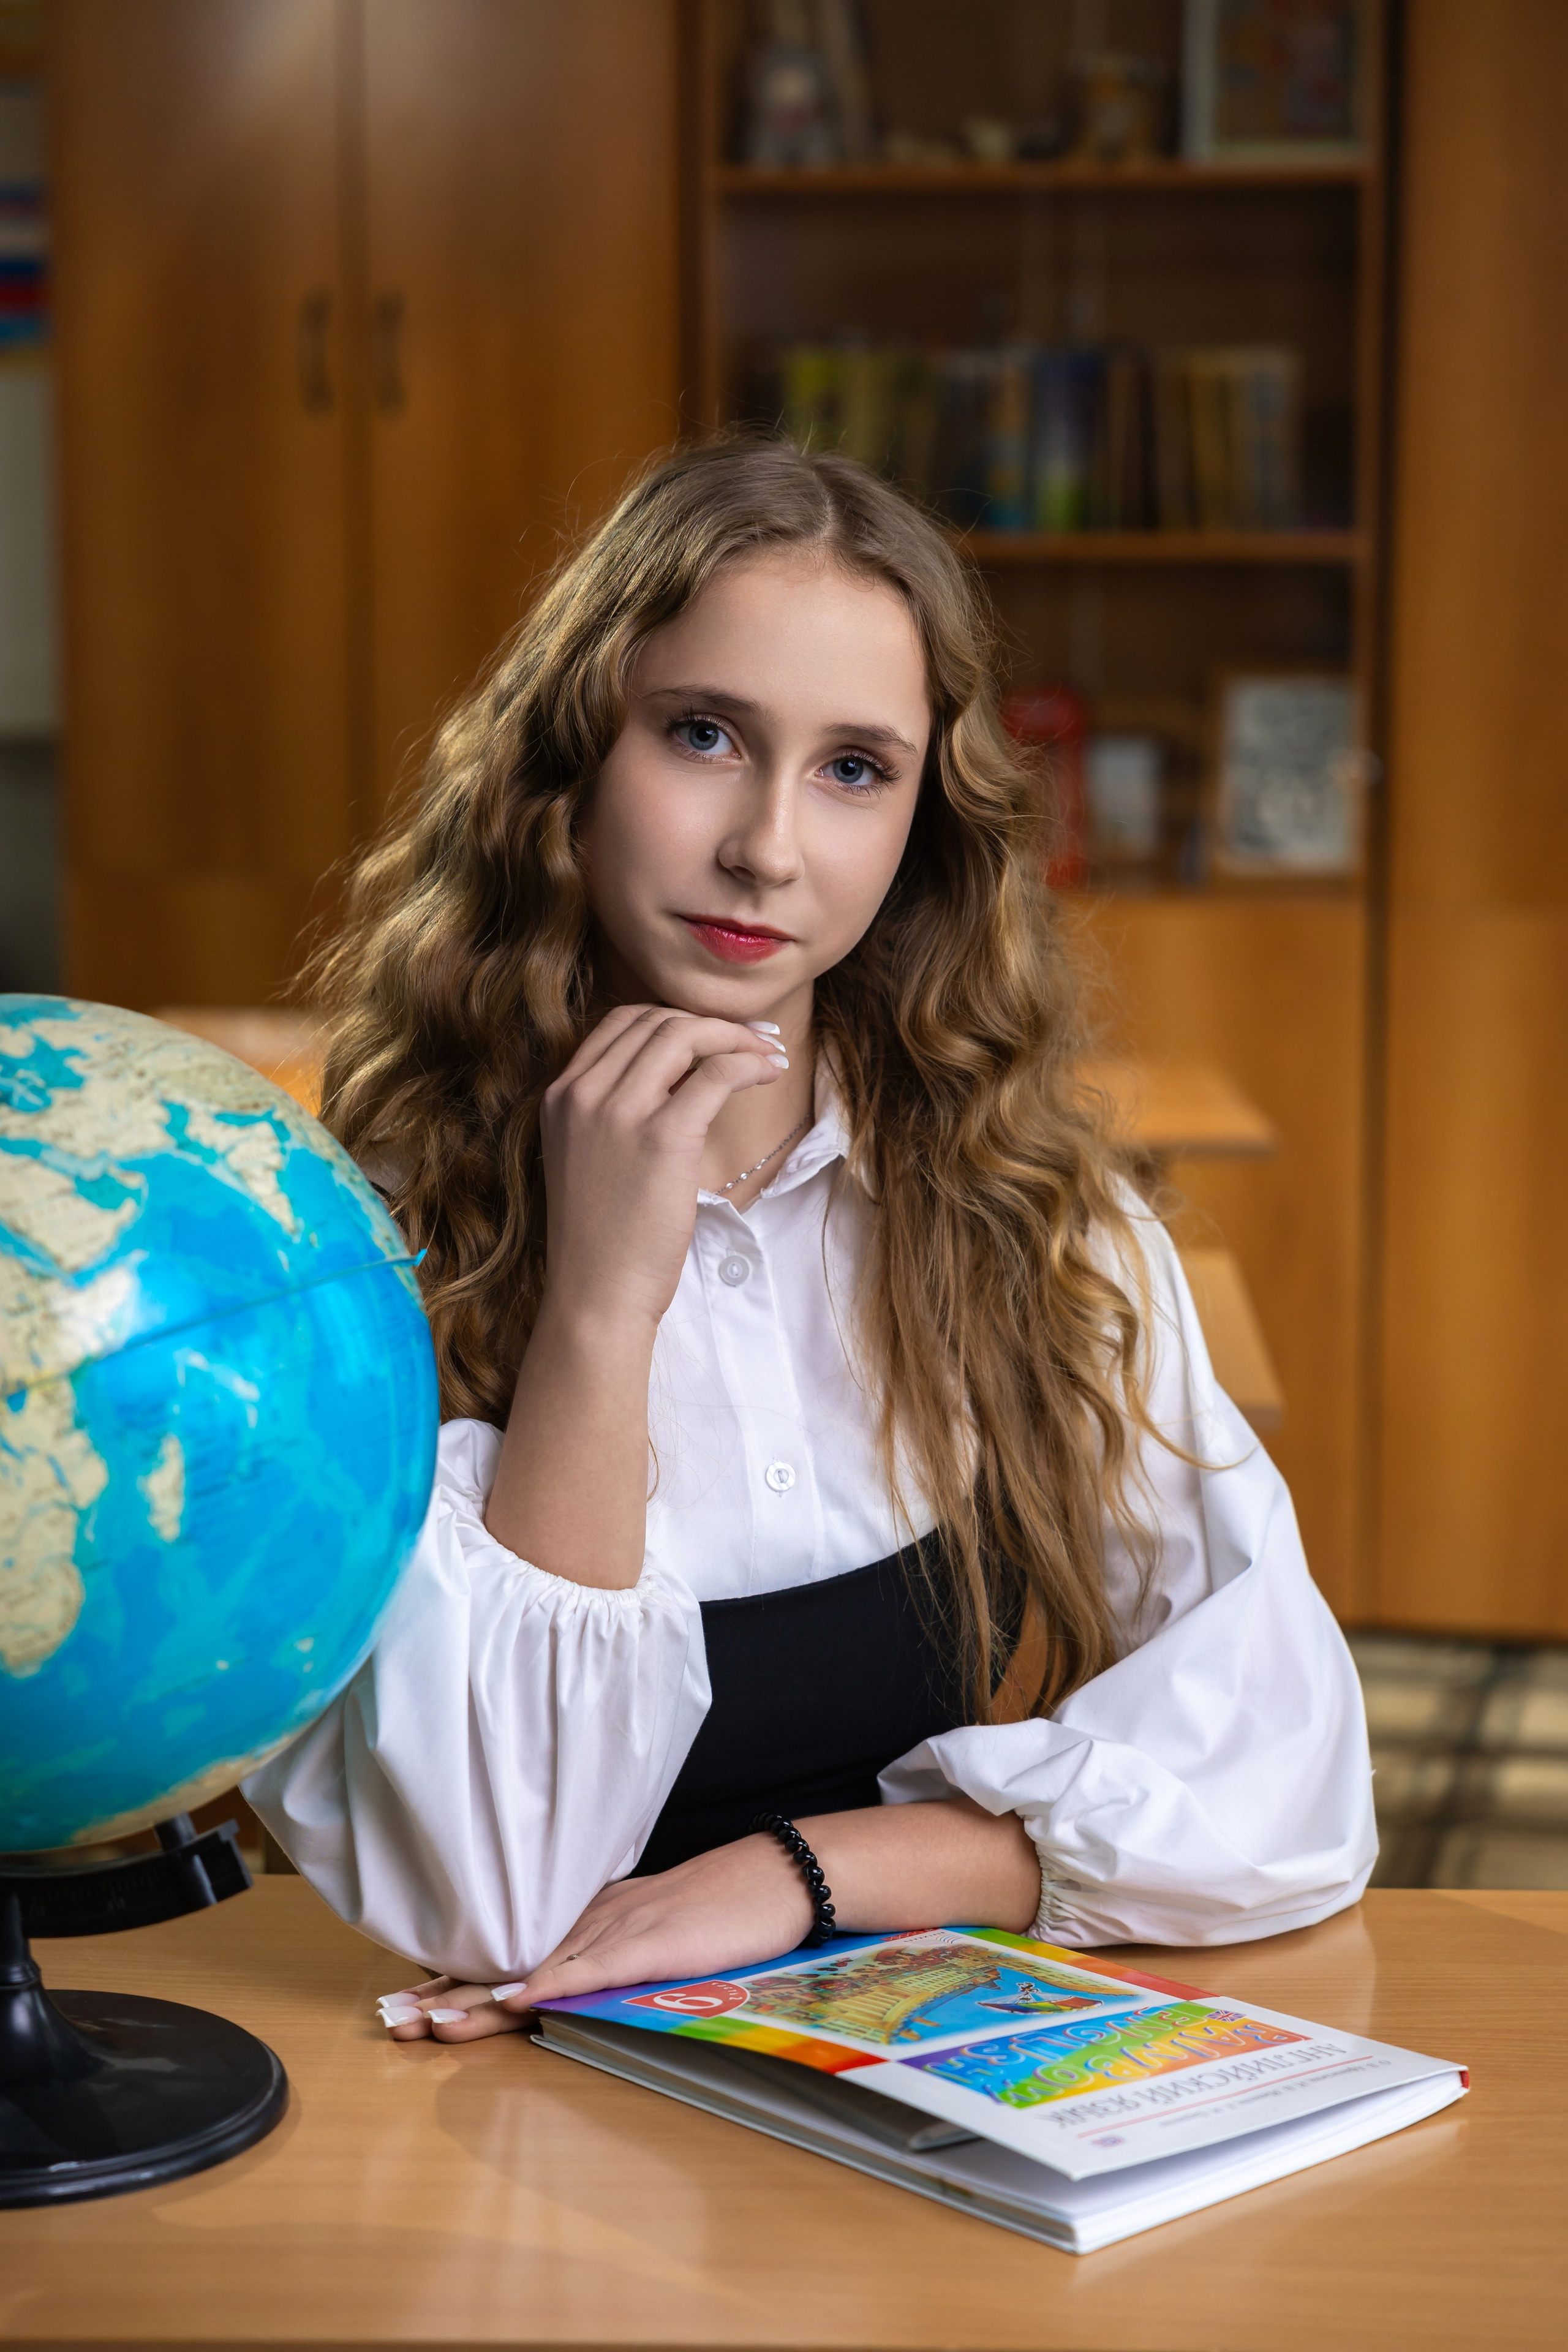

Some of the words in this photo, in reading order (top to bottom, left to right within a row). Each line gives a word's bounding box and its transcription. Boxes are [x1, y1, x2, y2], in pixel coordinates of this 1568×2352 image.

[653, 1993, 723, 2010] 9
[922, 2007, 1207, 2084] ENGLISH
[983, 2023, 1304, 2106] RAINBOW
[1133, 2043, 1347, 2105] АНГЛИЙСКИЙ
[1036, 2093, 1142, 2130] ЯЗЫК
